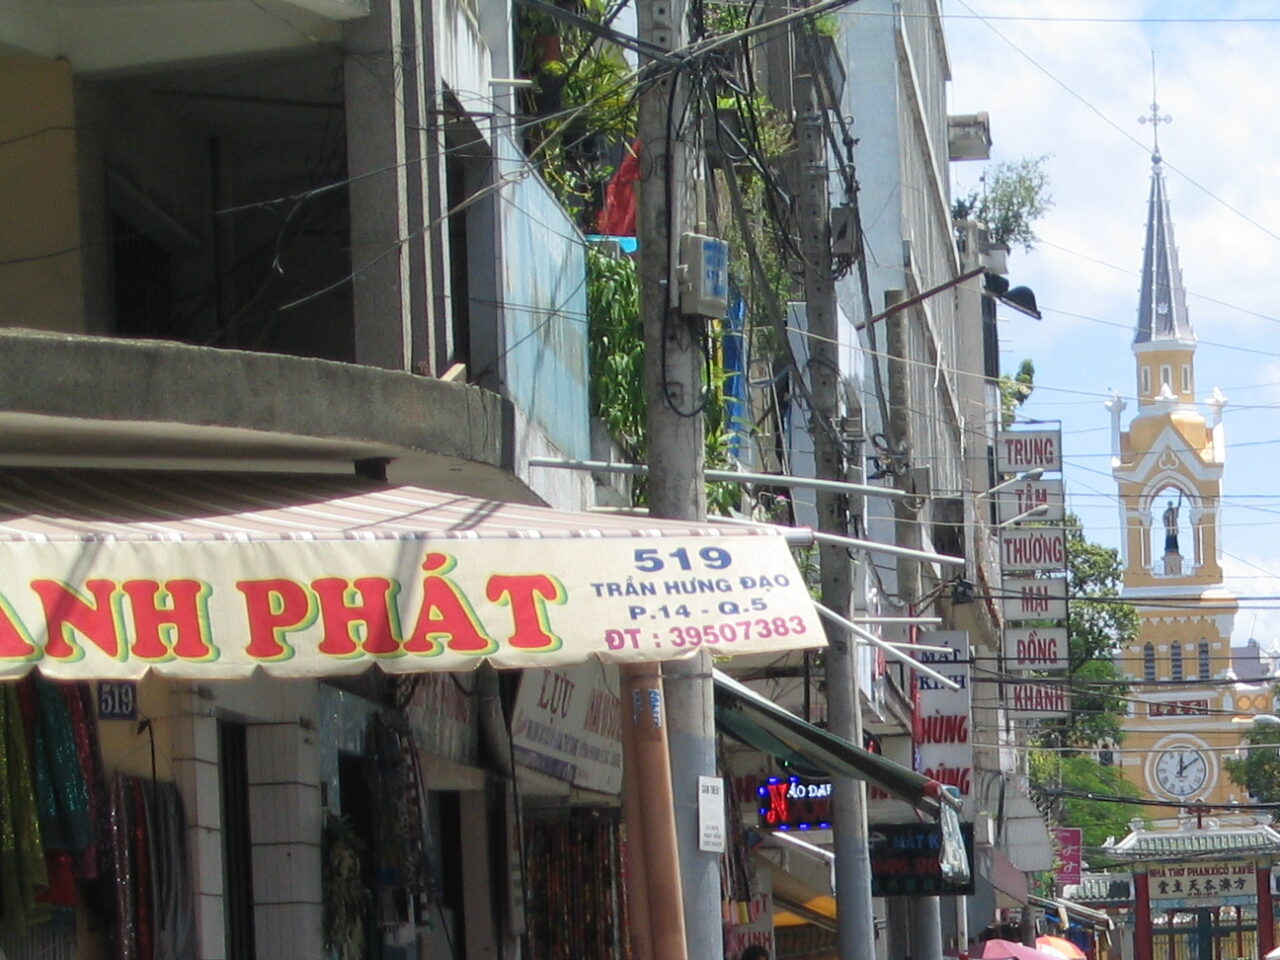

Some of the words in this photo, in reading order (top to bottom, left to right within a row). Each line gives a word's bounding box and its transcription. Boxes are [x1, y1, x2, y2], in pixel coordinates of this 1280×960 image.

[1005, 438, 1054, 465] TRUNG
[633, 546, 733, 573] 519
[1004, 532, 1063, 565] THƯƠNG
[664, 577, 733, 596] HƯNG
[741, 572, 791, 594] ĐẠO
[235, 551, 568, 662] PHÁT
[629, 603, 693, 621] P.14
[718, 597, 769, 617] Q.5
[1021, 586, 1049, 617] MẠI
[604, 628, 642, 651] ĐT
[668, 615, 808, 648] 39507383
[1016, 630, 1058, 665] ĐỒNG
[101, 683, 134, 715] 519
